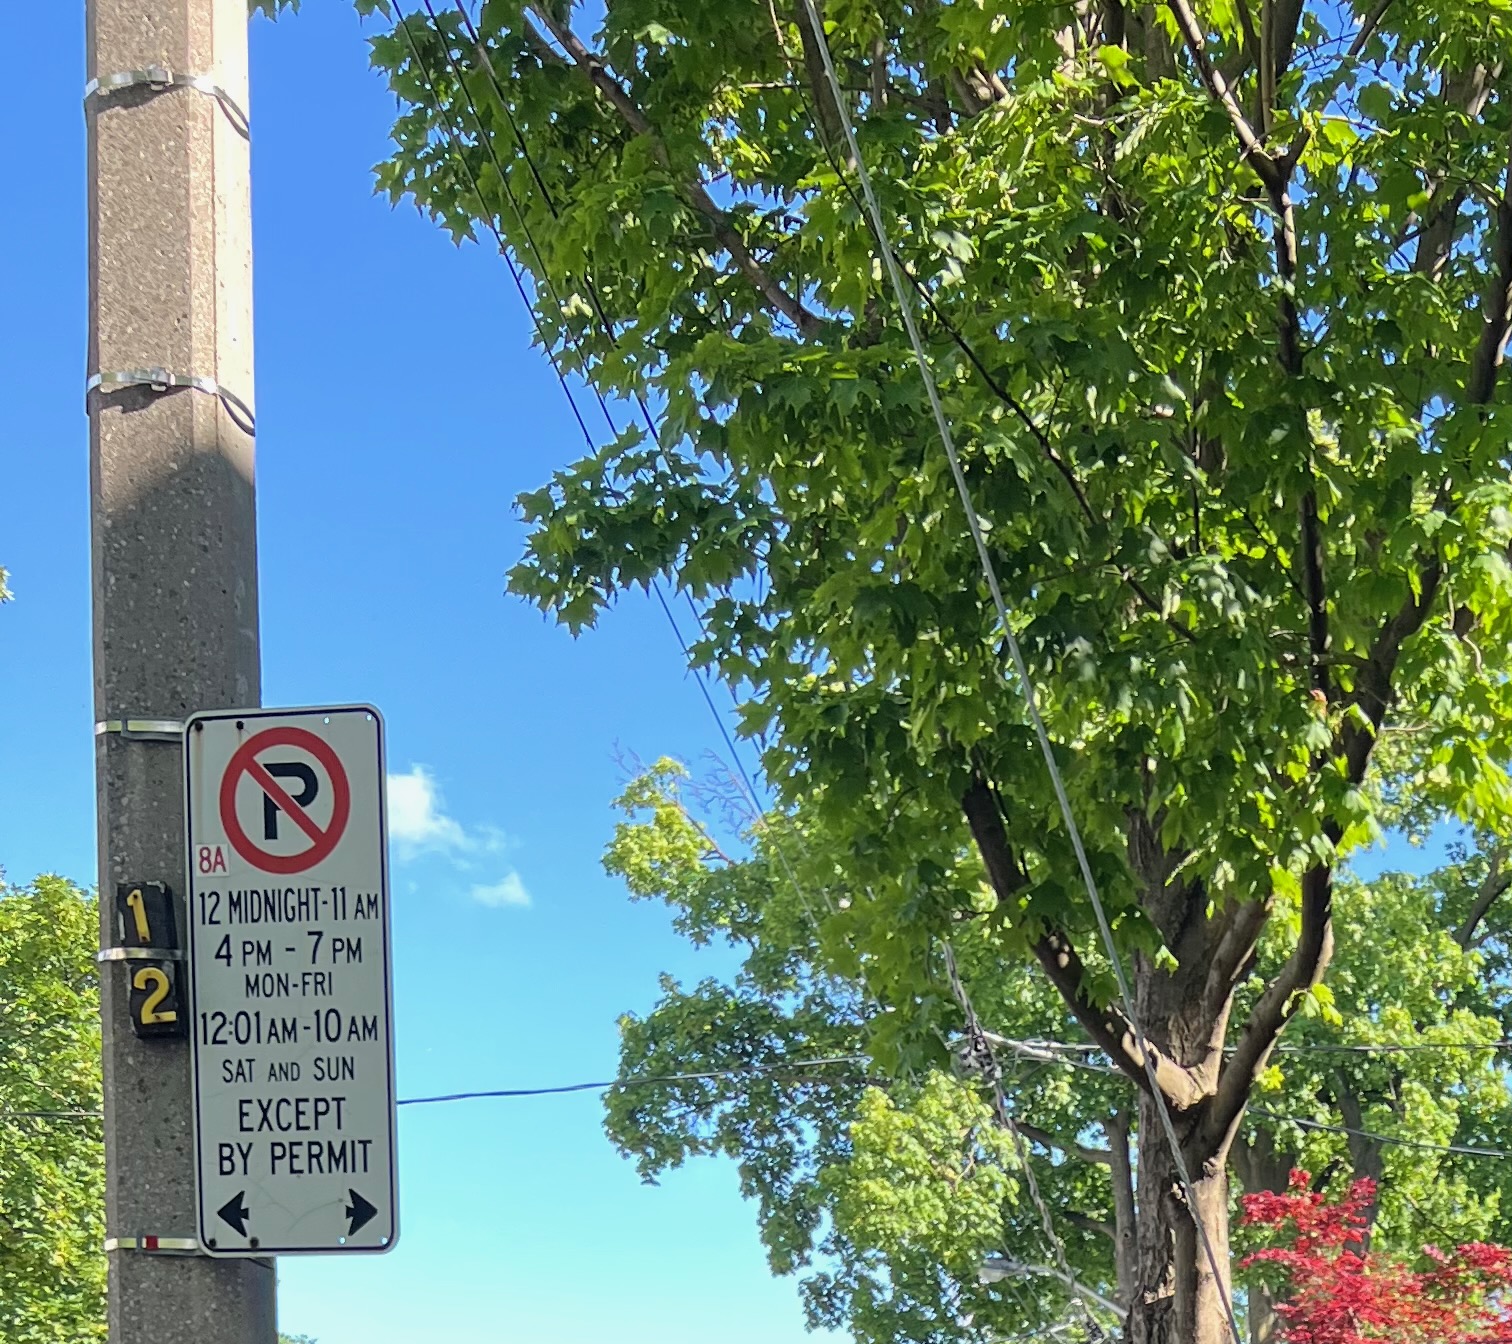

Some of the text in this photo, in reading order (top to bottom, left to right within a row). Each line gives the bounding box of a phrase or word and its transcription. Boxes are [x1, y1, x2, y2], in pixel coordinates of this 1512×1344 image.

[199, 846, 227, 873] 8A
[126, 888, 151, 943] 1
[199, 891, 221, 925] 12
[354, 894, 379, 920] AM
[215, 934, 233, 967] 4
[242, 940, 272, 966] PM
[307, 931, 324, 964] 7
[332, 937, 362, 964] PM
[134, 966, 177, 1025] 2
[245, 971, 333, 998] MON-FRI
[347, 1015, 379, 1042] AM
[222, 1056, 356, 1083] SAT AND SUN
[239, 1096, 346, 1132] EXCEPT
[218, 1139, 373, 1176] BY PERMIT
